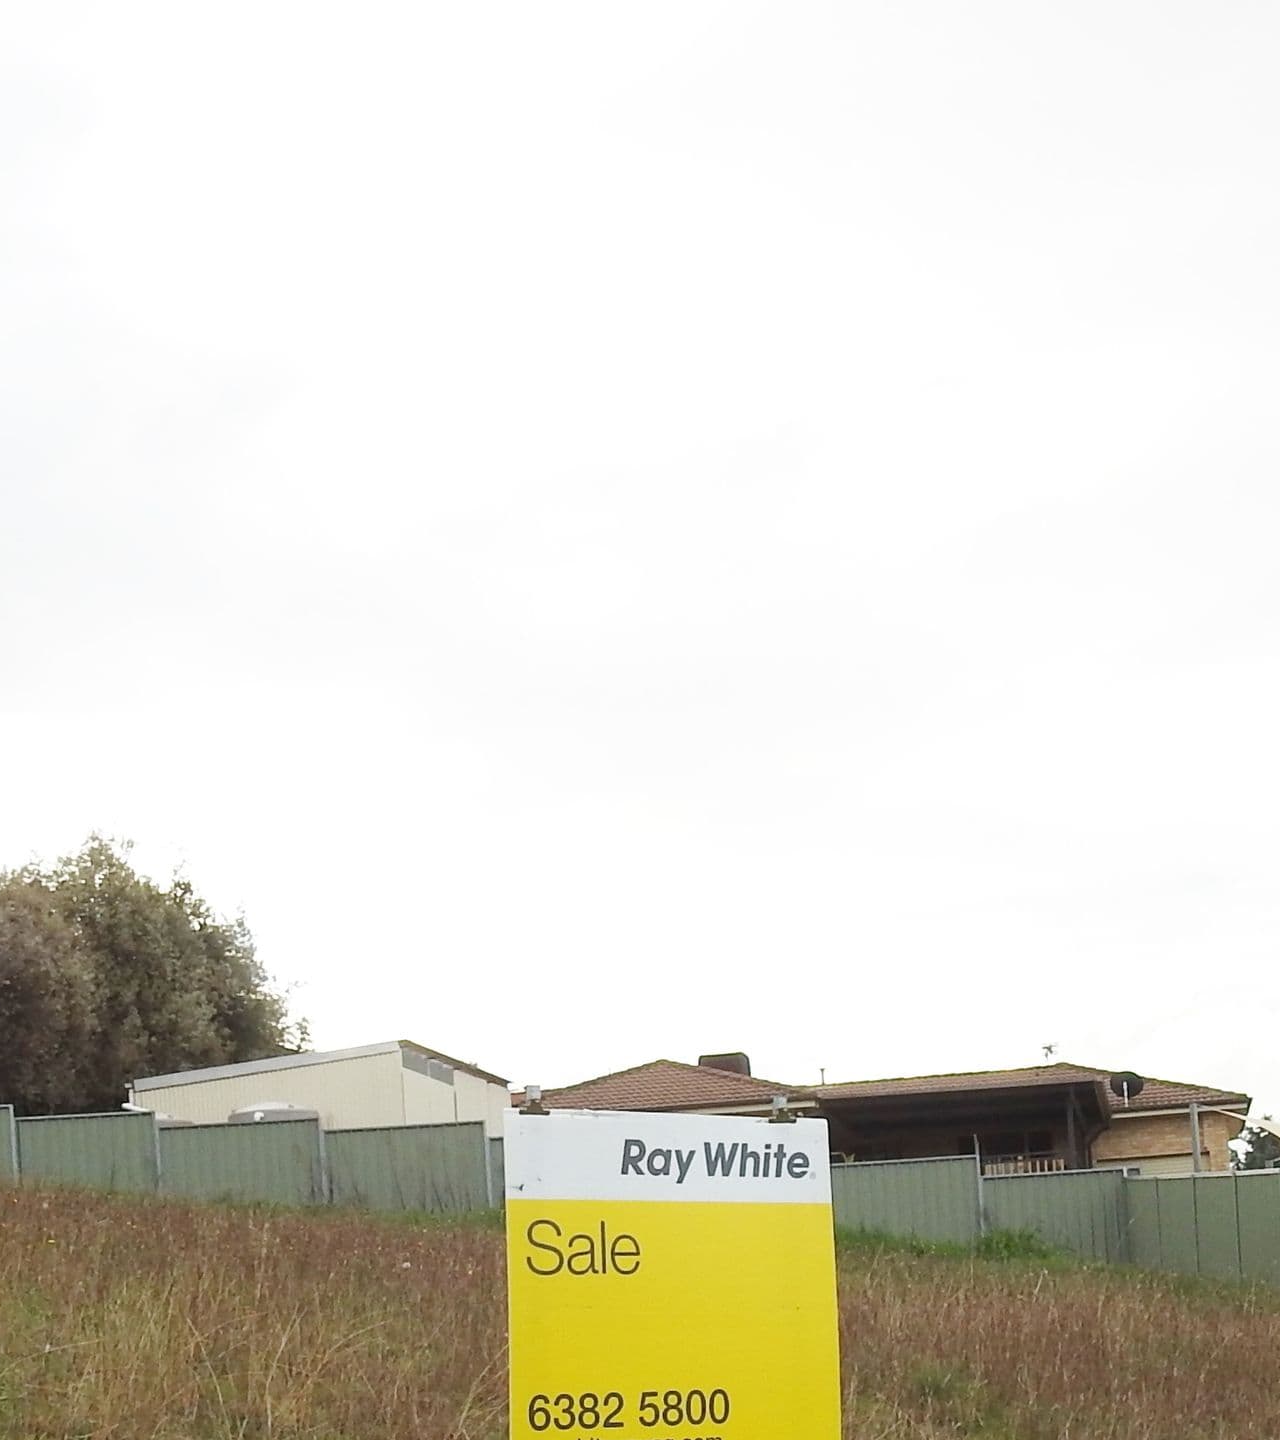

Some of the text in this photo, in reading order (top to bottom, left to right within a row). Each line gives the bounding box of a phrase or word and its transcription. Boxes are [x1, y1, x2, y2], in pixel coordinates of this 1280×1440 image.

[620, 1138, 810, 1184] Ray White
[526, 1219, 641, 1276] Sale
[528, 1388, 730, 1431] 6382 5800
